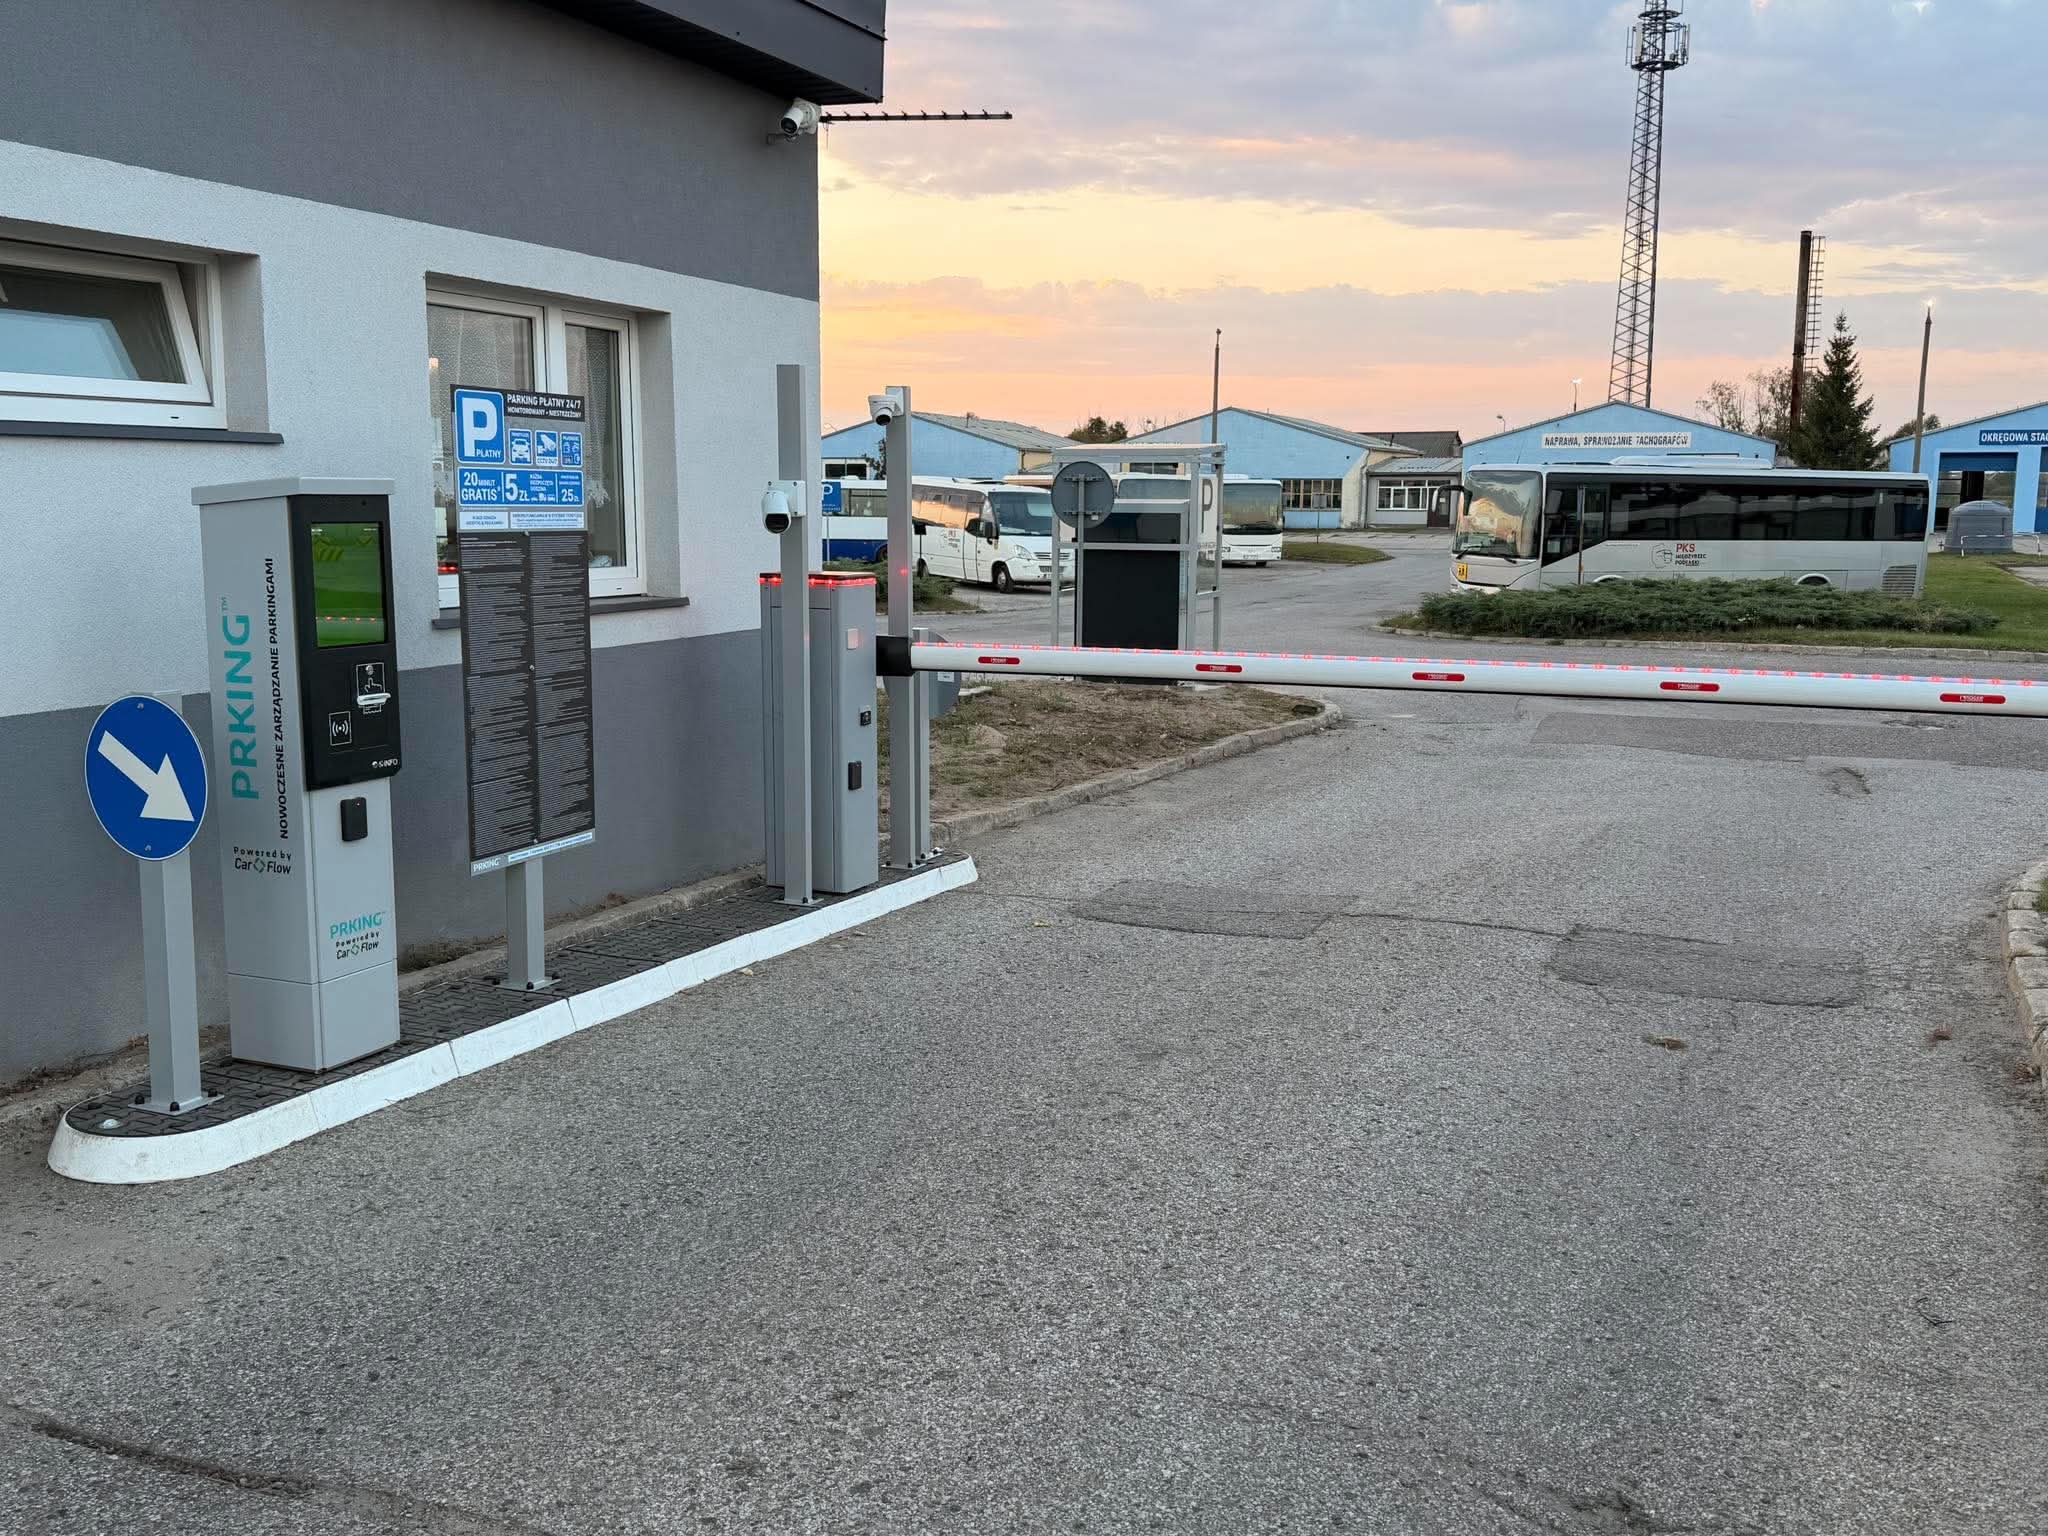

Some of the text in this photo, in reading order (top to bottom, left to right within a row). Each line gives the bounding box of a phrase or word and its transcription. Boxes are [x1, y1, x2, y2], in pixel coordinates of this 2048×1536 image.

[507, 393, 581, 409] PARKING PŁATNY 24/7
[462, 397, 498, 457] P
[1981, 432, 2029, 444] OKRĘGOWA
[476, 448, 502, 459] PŁATNY
[463, 472, 478, 487] 20
[505, 473, 519, 502] 5
[561, 488, 574, 502] 25
[1676, 543, 1696, 553] PKS
[265, 558, 289, 839] NOWOCZESNE ZARZĄDZANIE PARKINGAMI
[222, 615, 260, 800] PRKING
[233, 846, 292, 861] Powered by
[234, 857, 292, 875] Car Flow
[473, 858, 500, 873] PRKING
[329, 911, 383, 939] PRKING
[336, 932, 369, 948] Powered
[336, 941, 380, 960] Car Flow
